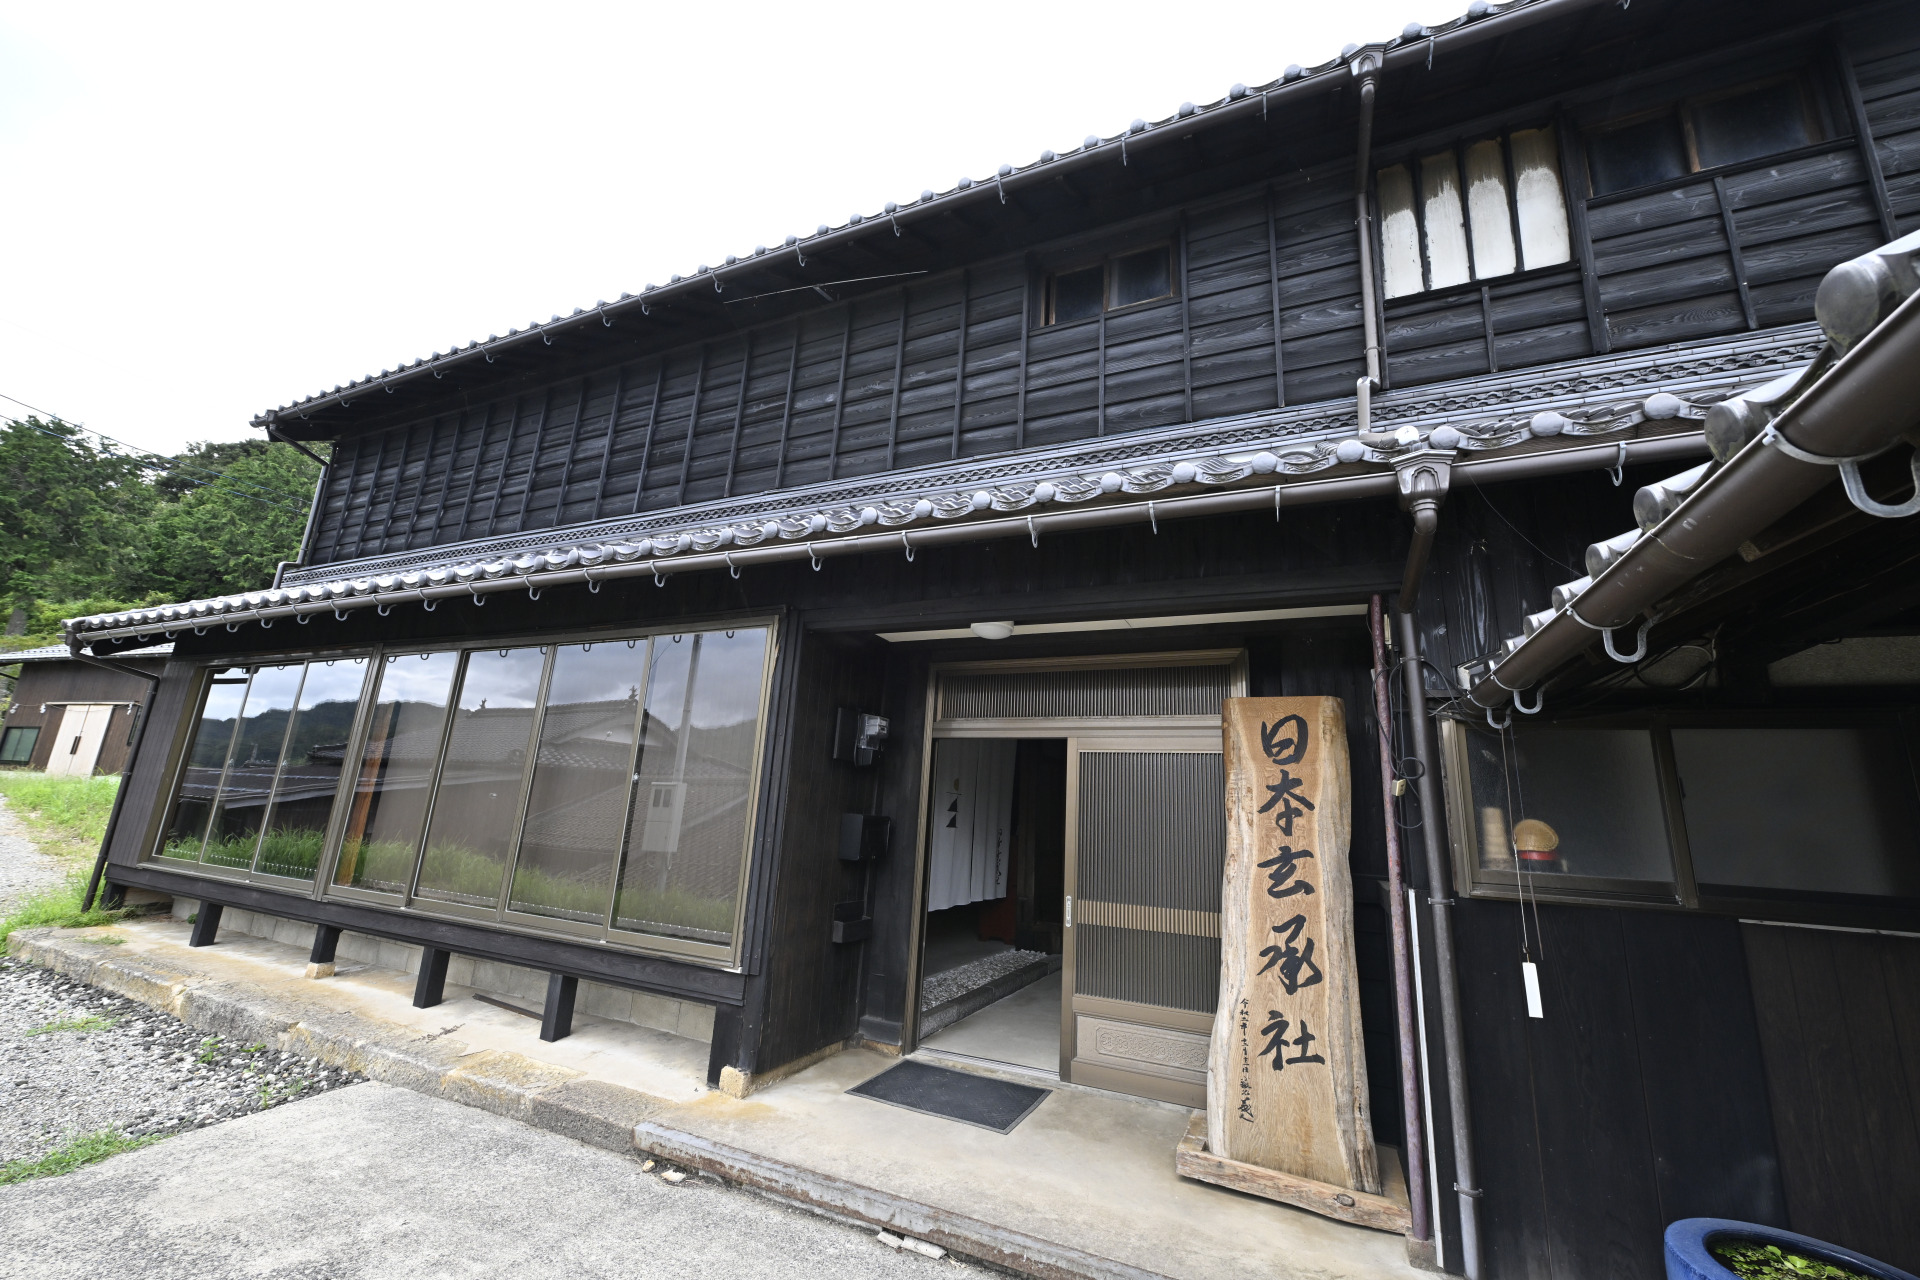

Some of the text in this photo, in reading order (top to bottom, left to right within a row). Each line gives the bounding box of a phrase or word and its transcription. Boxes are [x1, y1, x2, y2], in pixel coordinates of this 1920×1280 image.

[1256, 713, 1325, 1071] 日本玄承社
